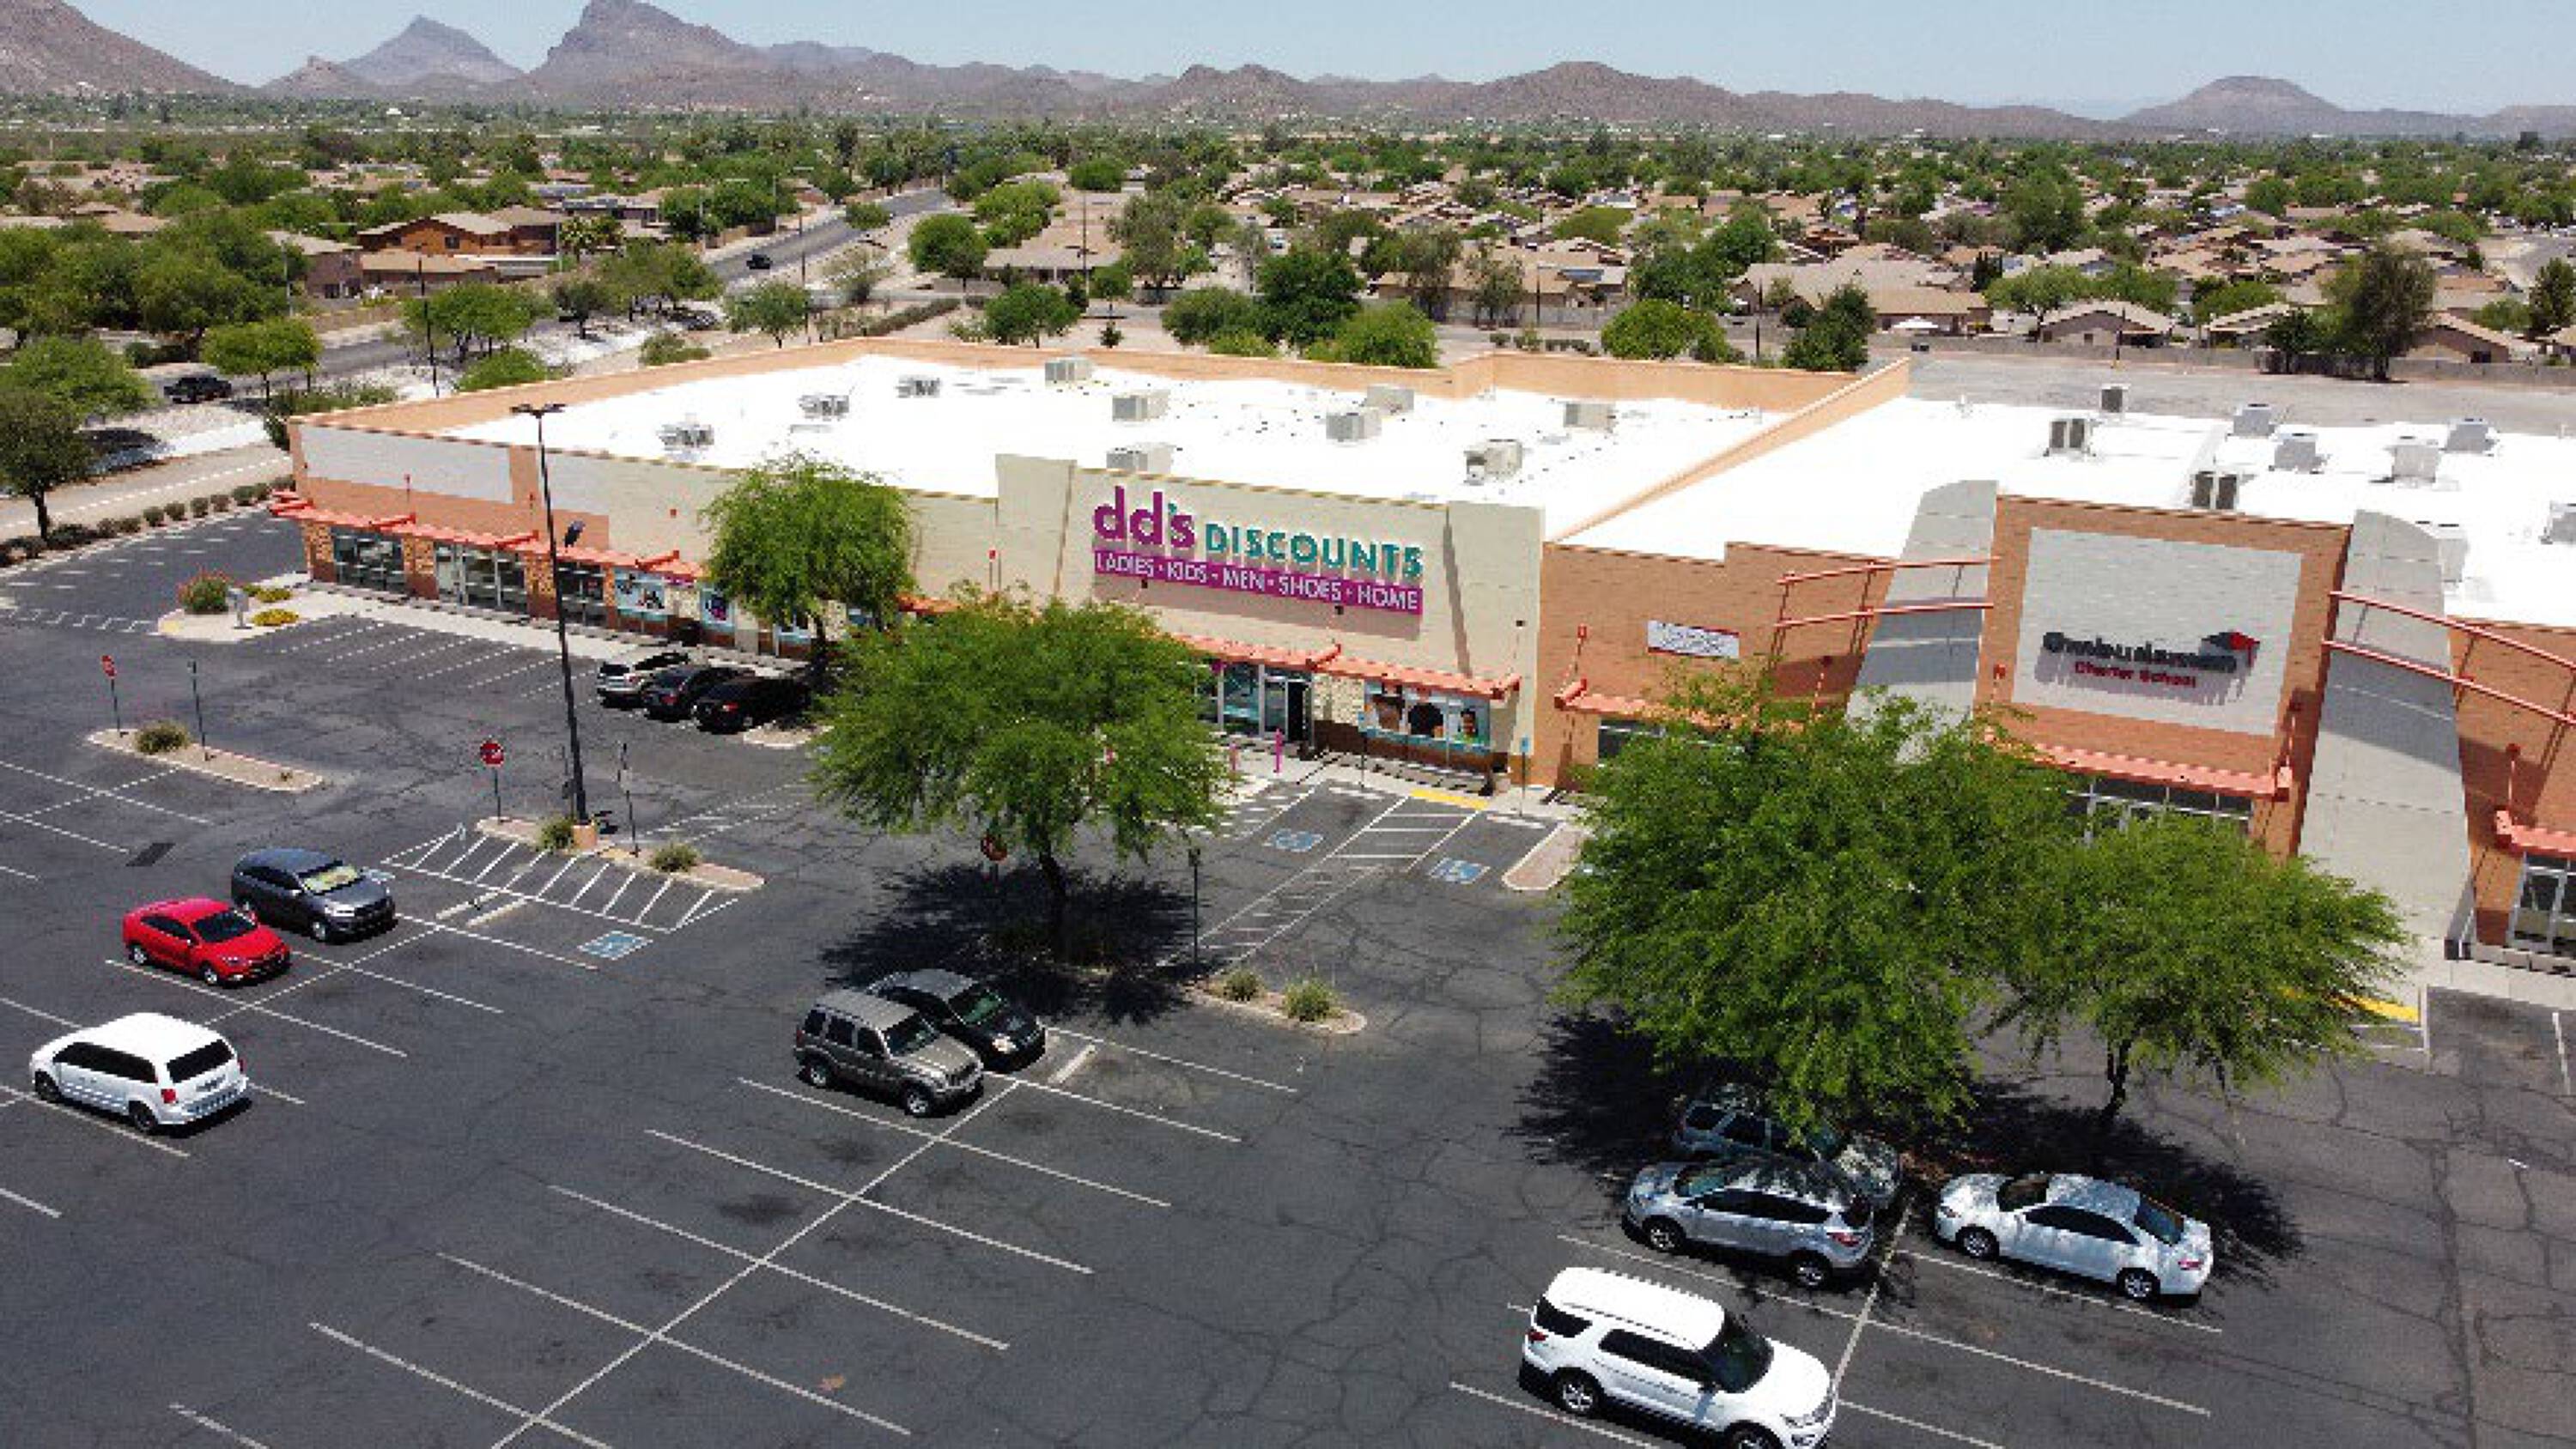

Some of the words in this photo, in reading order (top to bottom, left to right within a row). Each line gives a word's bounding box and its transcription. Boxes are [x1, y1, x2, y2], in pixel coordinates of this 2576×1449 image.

[1094, 485, 1195, 548] dd's
[1206, 524, 1424, 577] DISCOUNTS
[1096, 552, 1154, 577] LADIES
[1168, 561, 1206, 583] KIDS
[1223, 567, 1265, 591] MEN
[1279, 576, 1341, 601] SHOES
[1358, 585, 1418, 609] HOME
[2139, 669, 2196, 688] School
